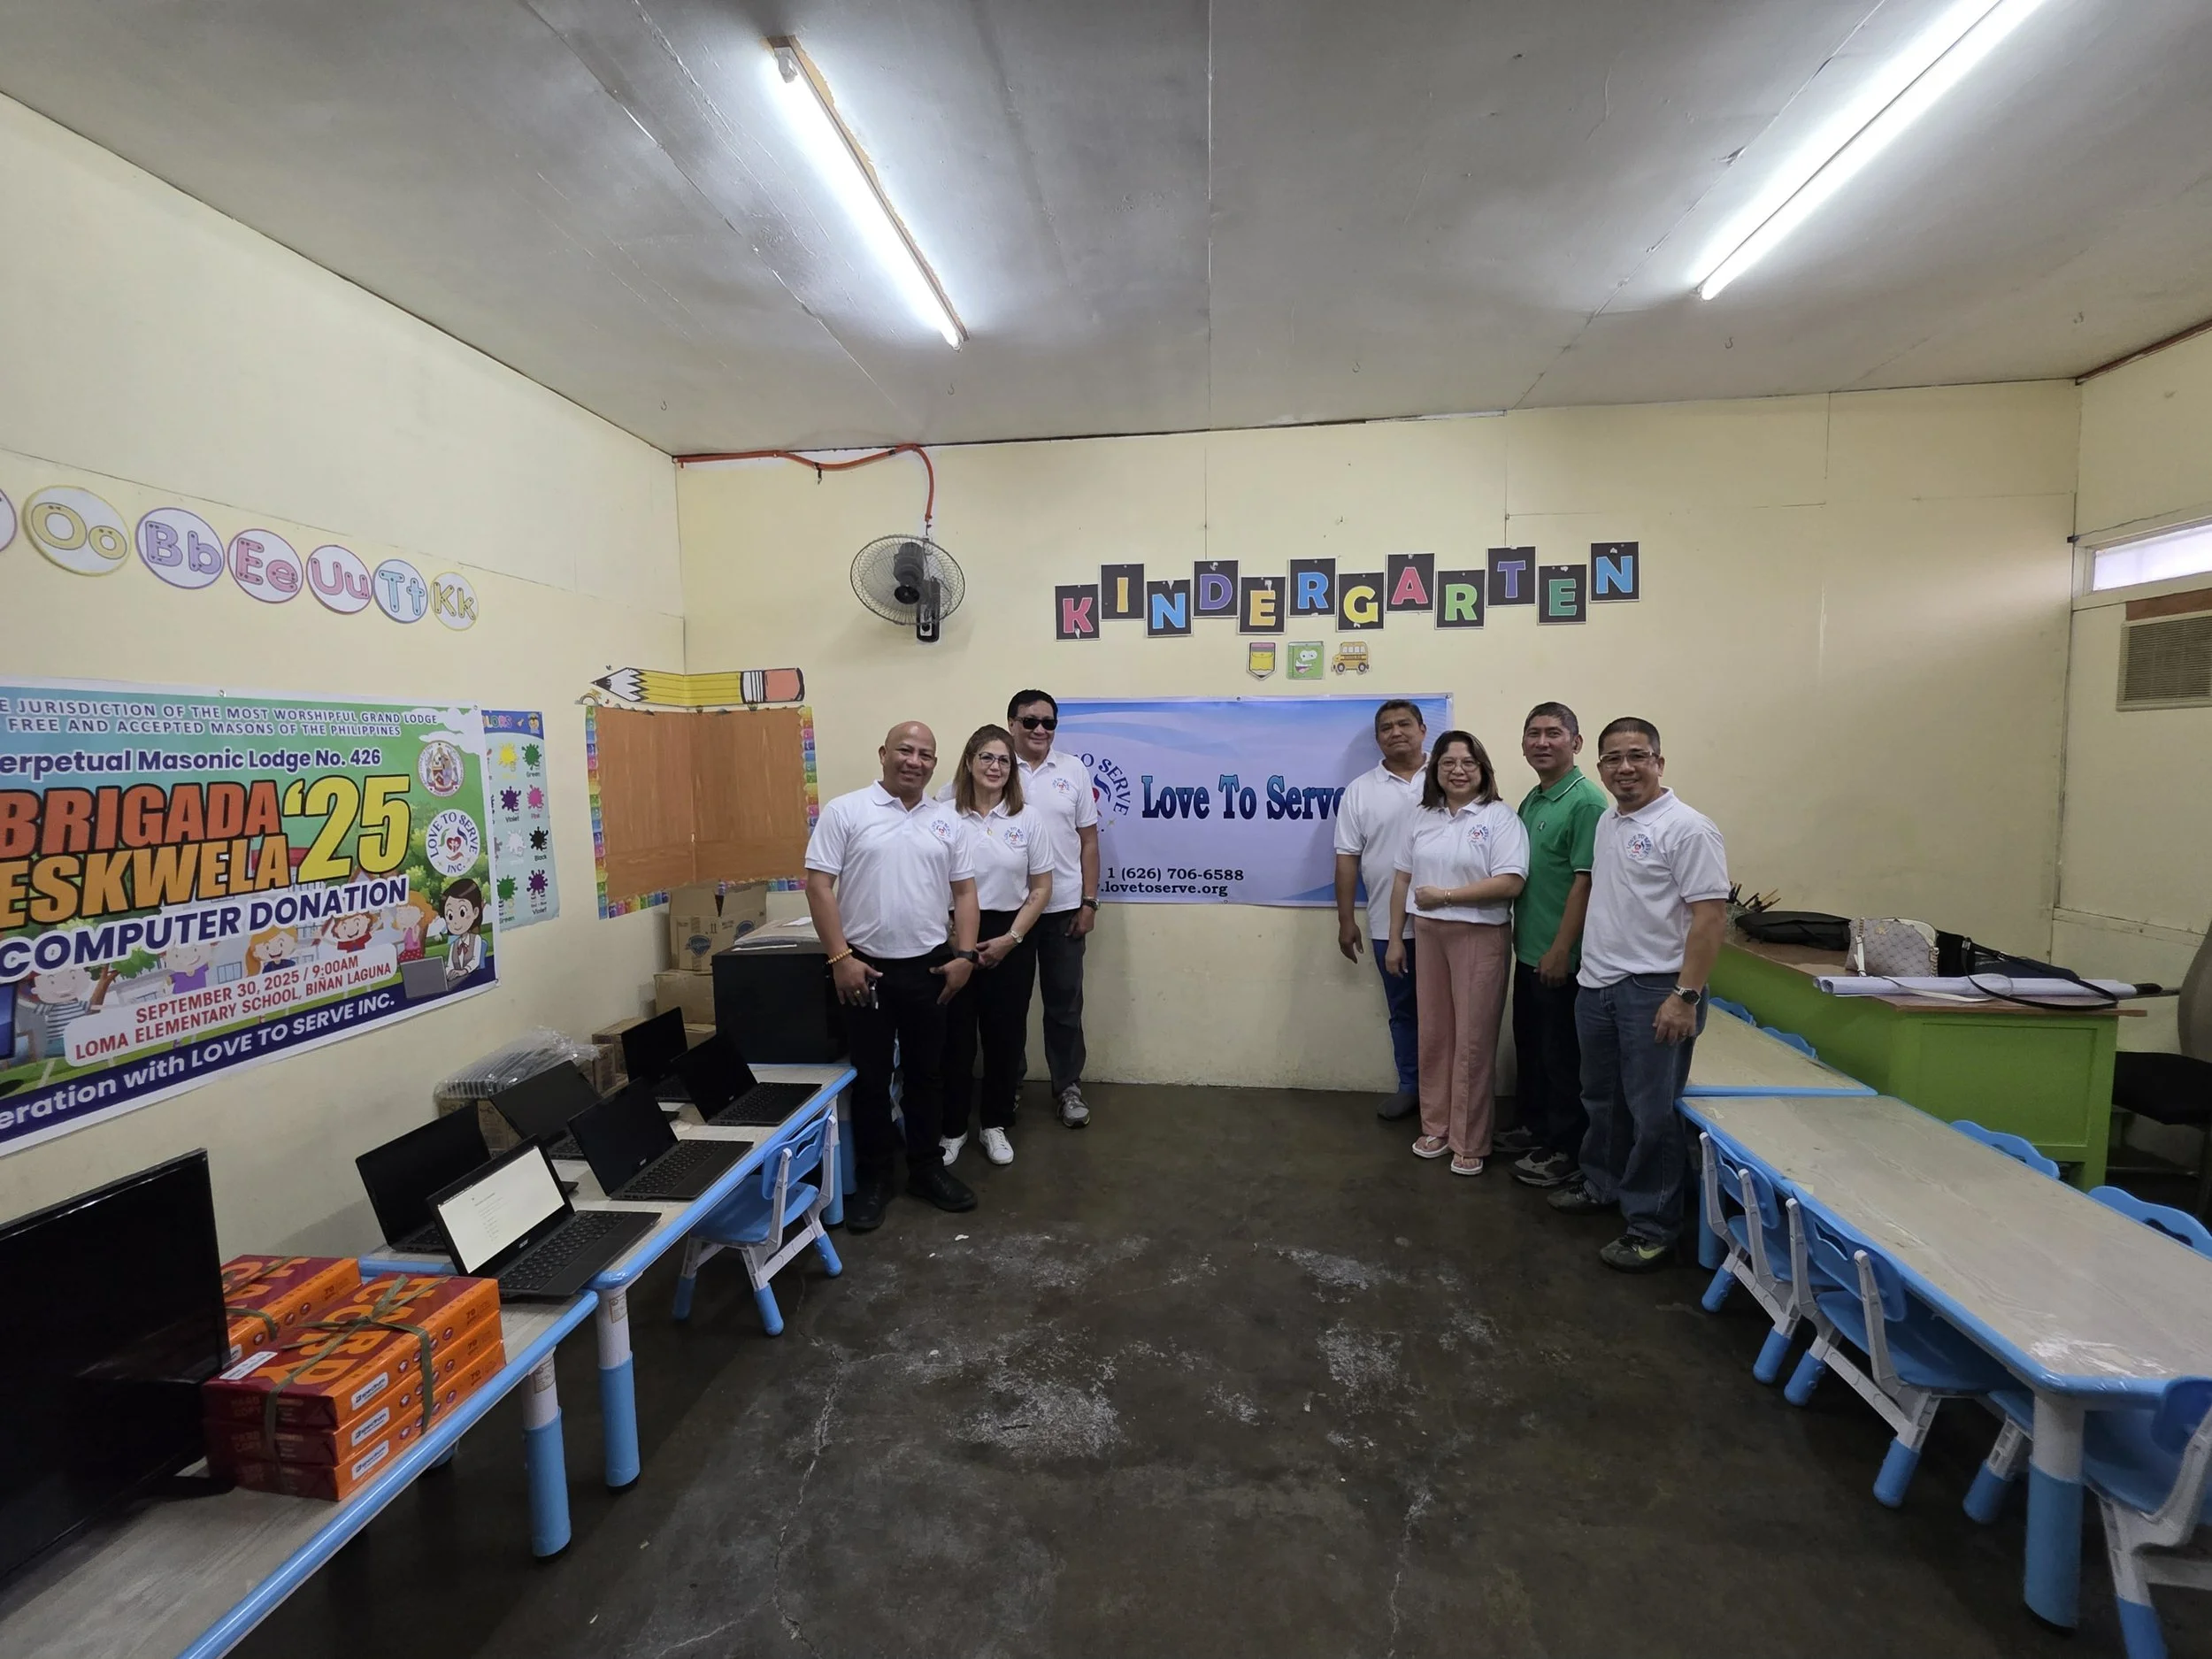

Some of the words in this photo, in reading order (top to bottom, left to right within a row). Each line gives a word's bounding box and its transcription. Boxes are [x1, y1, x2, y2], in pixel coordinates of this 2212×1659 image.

[31, 502, 127, 560] Oo
[145, 521, 222, 575] Bb
[236, 537, 298, 593] Ee
[310, 557, 371, 600] Uu
[378, 569, 426, 617] Tt
[434, 581, 477, 621] Kk
[1062, 555, 1634, 634] KINDERGARTEN
[9, 718, 59, 732] FREE
[68, 718, 108, 733] AND
[117, 720, 204, 733] ACCEPTED
[211, 722, 273, 735] MASONS
[280, 724, 296, 735] OF
[302, 724, 326, 735] THE
[330, 725, 402, 736] PHILIPPINES
[19, 700, 156, 717] JURISDICTION
[163, 705, 185, 718] OF
[191, 706, 220, 718] THE
[227, 708, 268, 720] MOST
[273, 710, 357, 722] WORSHIPFUL
[362, 712, 401, 723] GRAND
[404, 713, 437, 724] LODGE
[138, 748, 244, 771] Masonic
[249, 749, 311, 772] Lodge
[316, 749, 346, 766] No.
[350, 749, 381, 765] 426
[1098, 758, 1132, 816] SERVE
[1141, 774, 1210, 819] Love
[1217, 773, 1257, 820] To
[0, 780, 281, 858] BRIGADA
[427, 818, 444, 858] LOVE
[442, 811, 457, 825] TO
[458, 814, 479, 856] SERVE
[0, 834, 290, 930] ESKWELA
[447, 864, 466, 874] INC.
[1098, 881, 1228, 896] .lovetoserve.org
[1108, 867, 1116, 879] 1
[1121, 867, 1161, 882] (626)
[1167, 868, 1244, 880] 706-6588
[1, 907, 242, 974] COMPUTER
[249, 878, 408, 930] DONATION
[75, 1033, 128, 1060] LOMA
[135, 1006, 236, 1045] ELEMENTARY
[241, 989, 303, 1017] SCHOOL,
[305, 974, 344, 997] BIÑAN
[347, 963, 392, 985] LAGUNA
[135, 989, 233, 1024] SEPTEMBER
[236, 982, 261, 1004] 30,
[265, 972, 300, 991] 2025
[303, 965, 309, 980] /
[311, 955, 359, 979] 9:00AM
[124, 1055, 185, 1090] with
[191, 1034, 254, 1067] LOVE
[256, 1023, 288, 1047] TO
[292, 1006, 355, 1036] SERVE
[358, 994, 396, 1018] INC.
